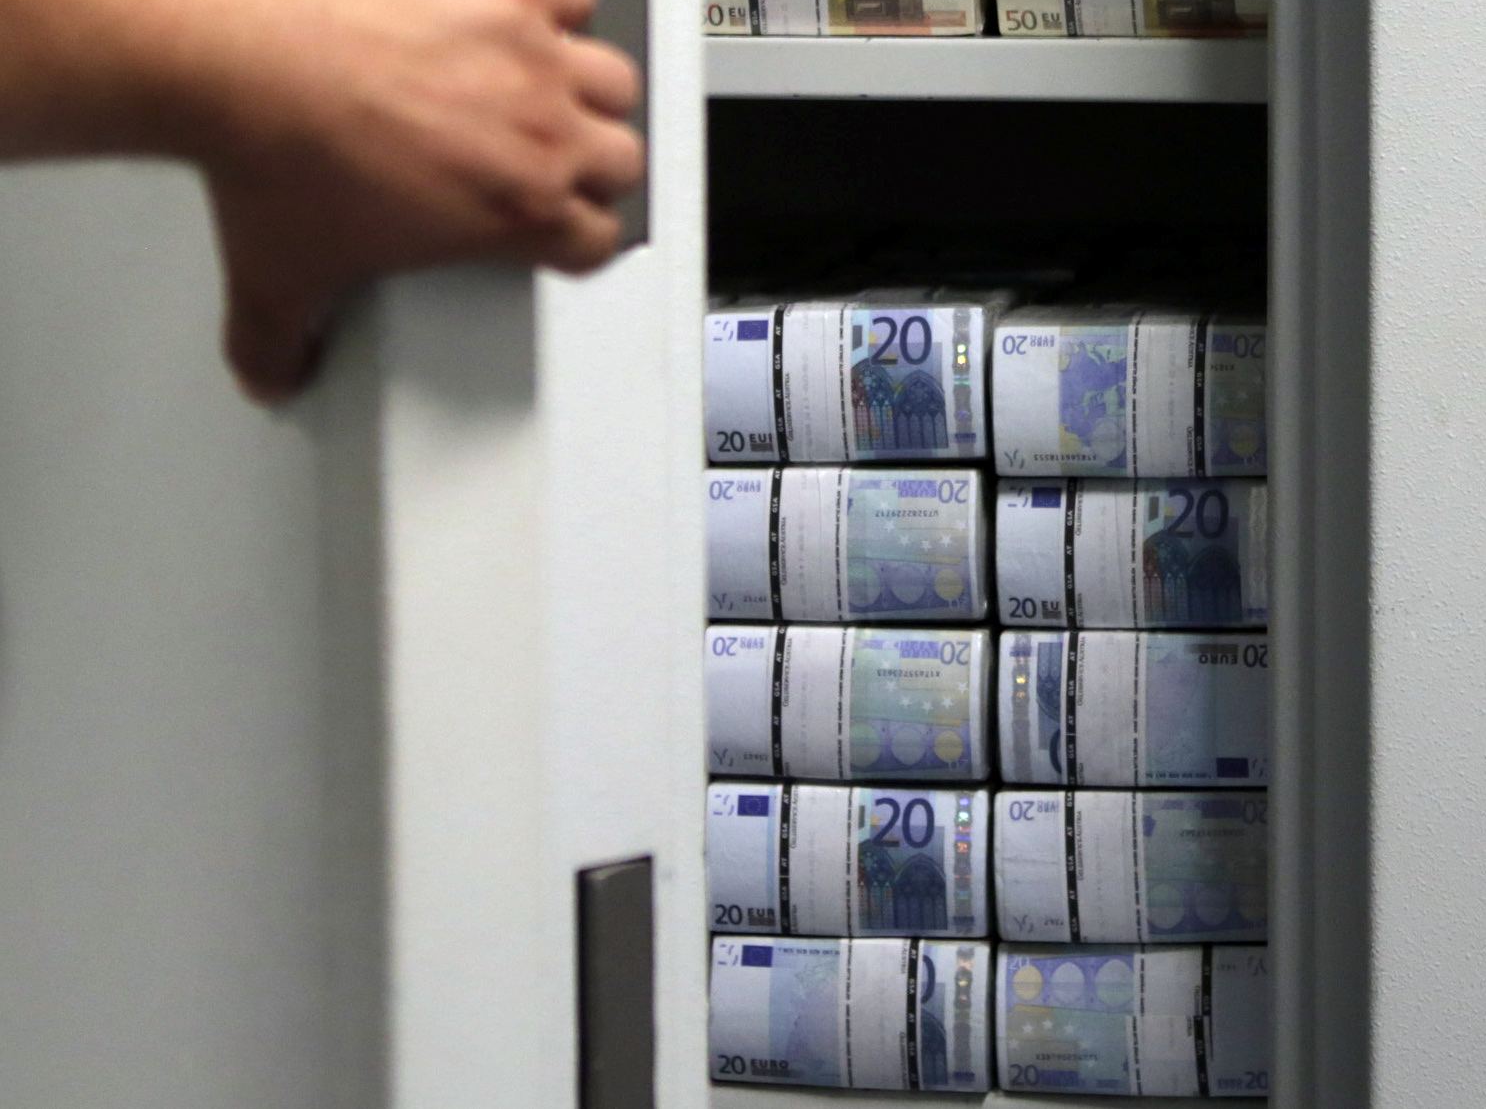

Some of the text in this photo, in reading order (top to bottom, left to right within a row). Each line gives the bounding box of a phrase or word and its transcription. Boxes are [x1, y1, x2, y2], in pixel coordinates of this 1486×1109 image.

[1006, 10, 1037, 31] 50
[775, 326, 780, 336] AT
[872, 315, 933, 366] 20
[1002, 335, 1028, 355] 20
[717, 431, 745, 453] 20
[709, 480, 735, 501] 20
[938, 479, 968, 504] 20
[1168, 489, 1229, 540] 20
[1009, 597, 1036, 619] 20
[712, 636, 738, 656] 20
[940, 641, 970, 666] 20
[1009, 800, 1035, 821] 20
[874, 797, 935, 848] 20
[715, 904, 742, 925] 20
[717, 1055, 789, 1075] 20 EURO
[1010, 1064, 1040, 1086] 20
